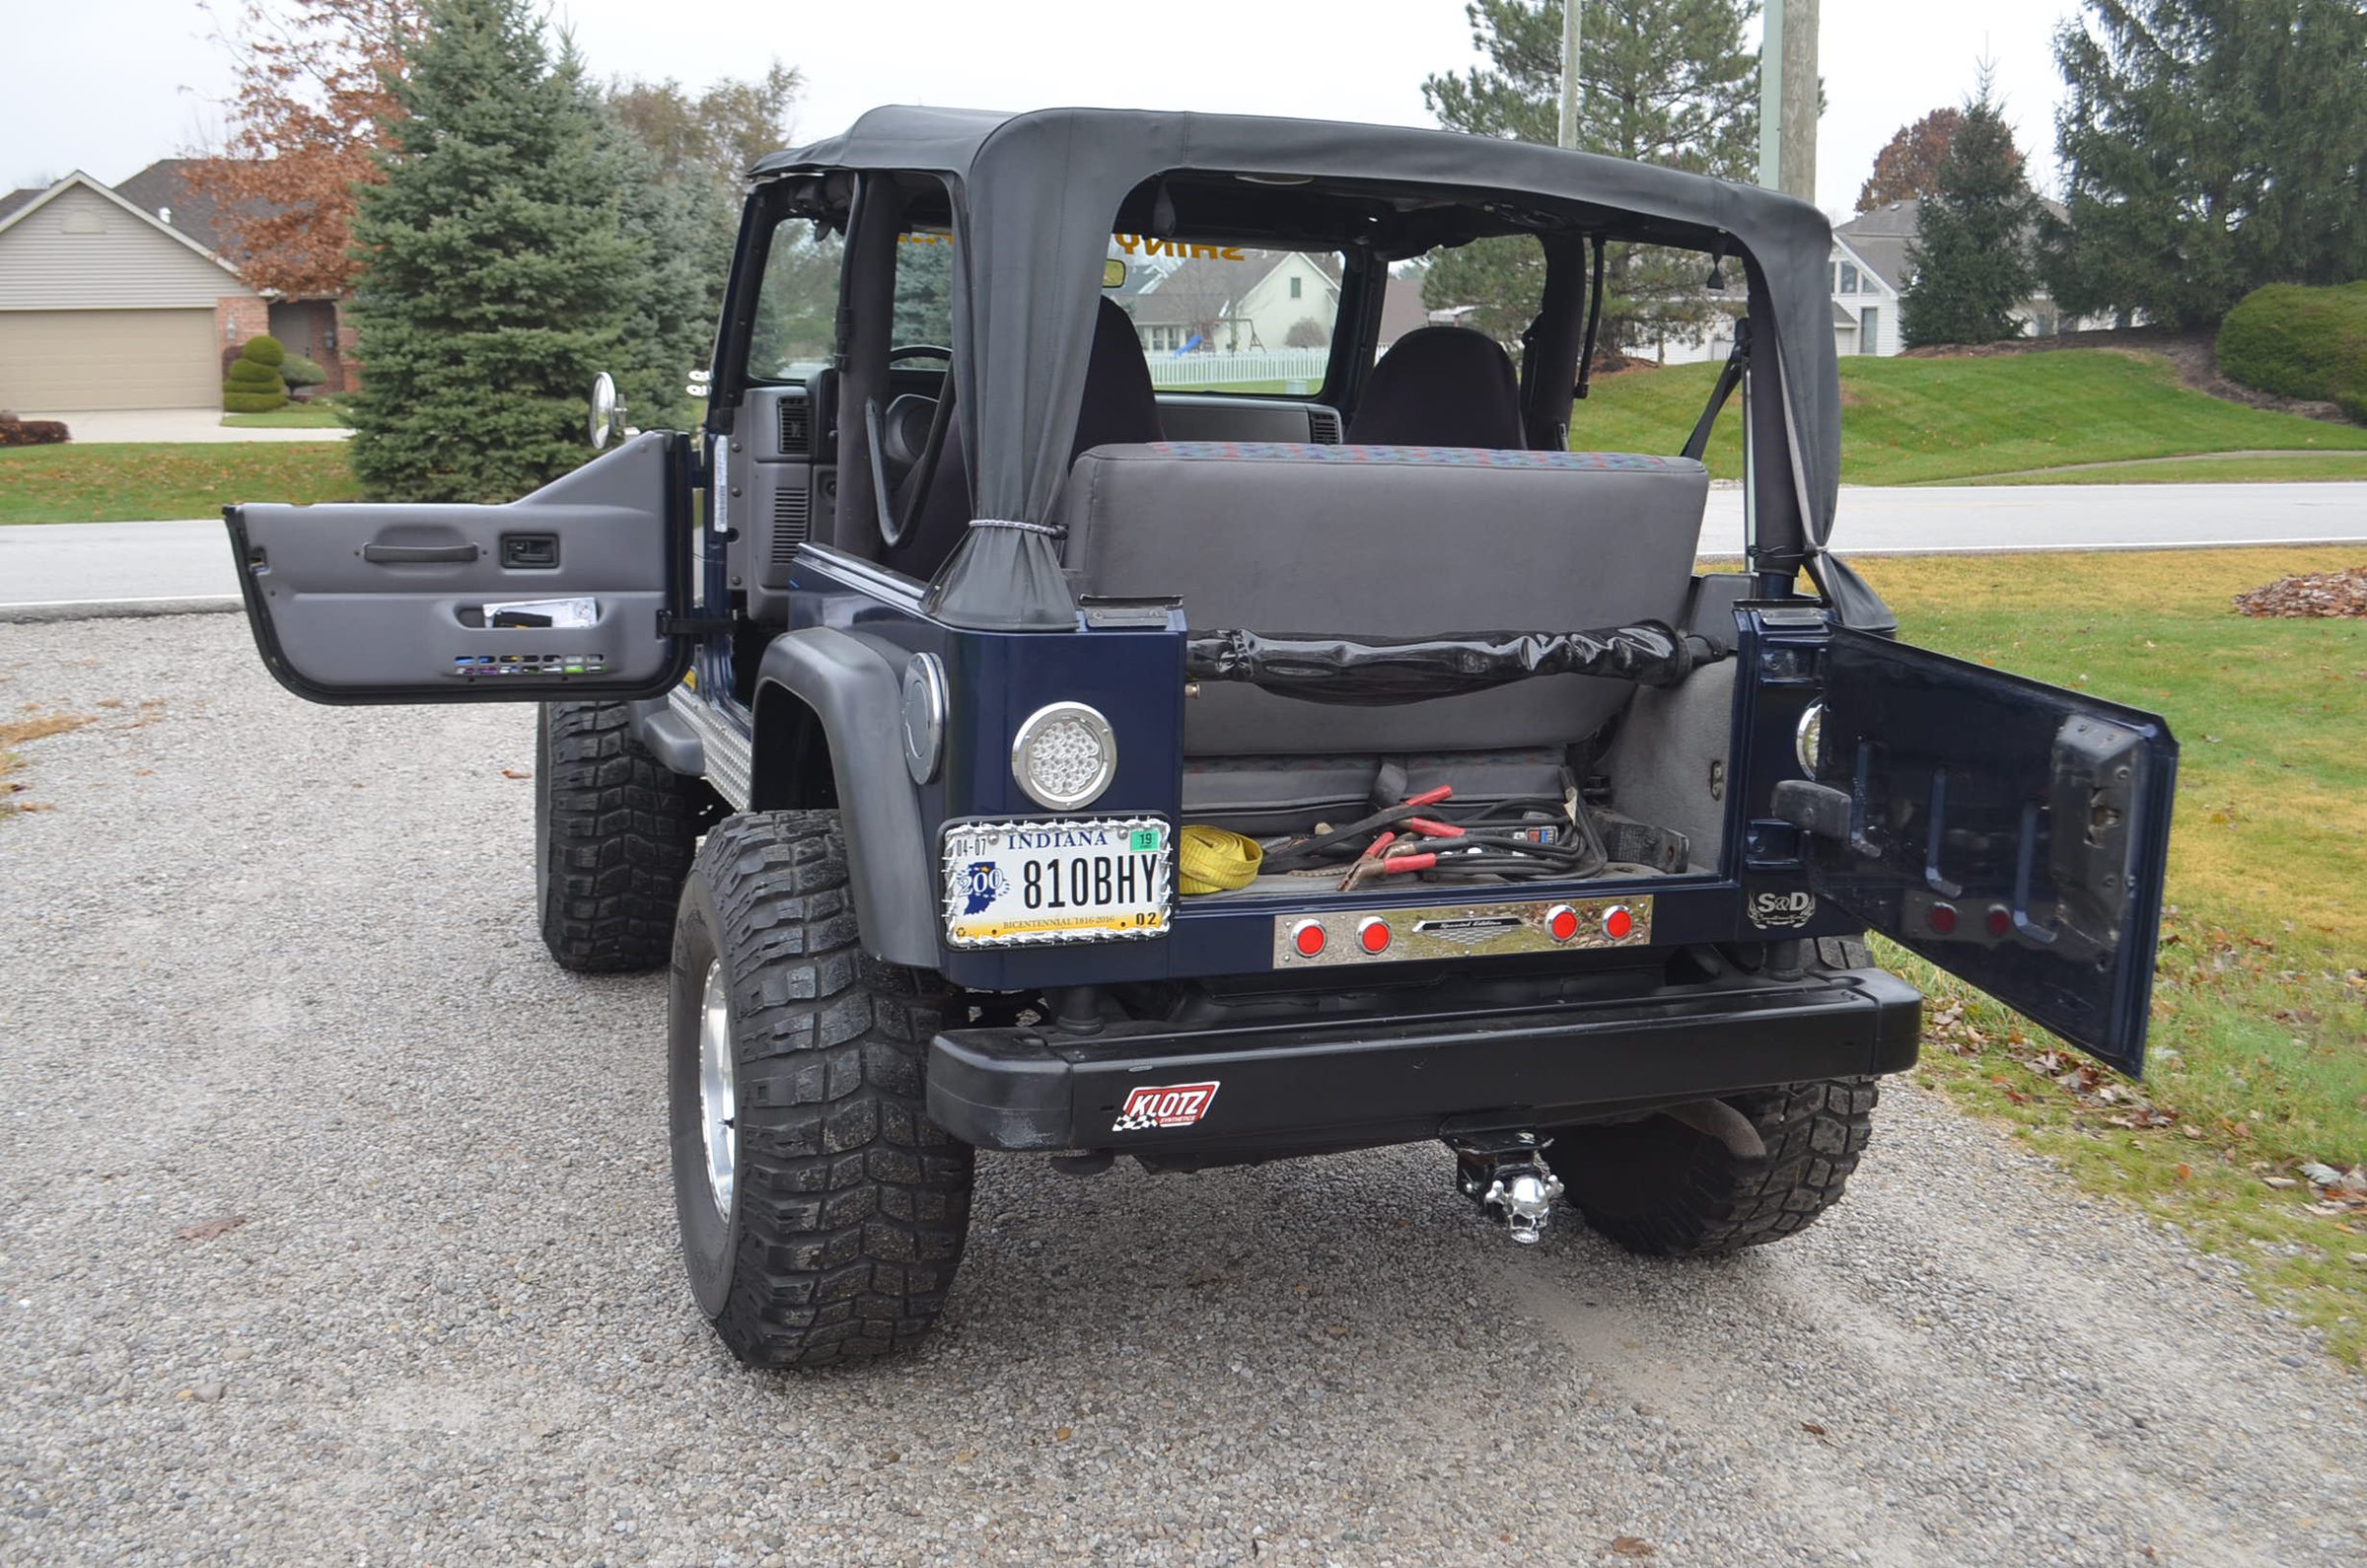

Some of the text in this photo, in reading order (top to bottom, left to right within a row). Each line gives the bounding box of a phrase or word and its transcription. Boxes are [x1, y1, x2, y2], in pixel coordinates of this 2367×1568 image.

[1007, 830, 1109, 850] INDIANA
[1138, 832, 1152, 844] 19
[958, 868, 1003, 897] 200
[1023, 854, 1158, 909] 810BHY
[1757, 891, 1810, 913] S&D
[1003, 915, 1115, 929] BICENTENNIAL 1816-2016
[1135, 912, 1157, 926] 02
[1129, 1090, 1208, 1117] KLOTZ
